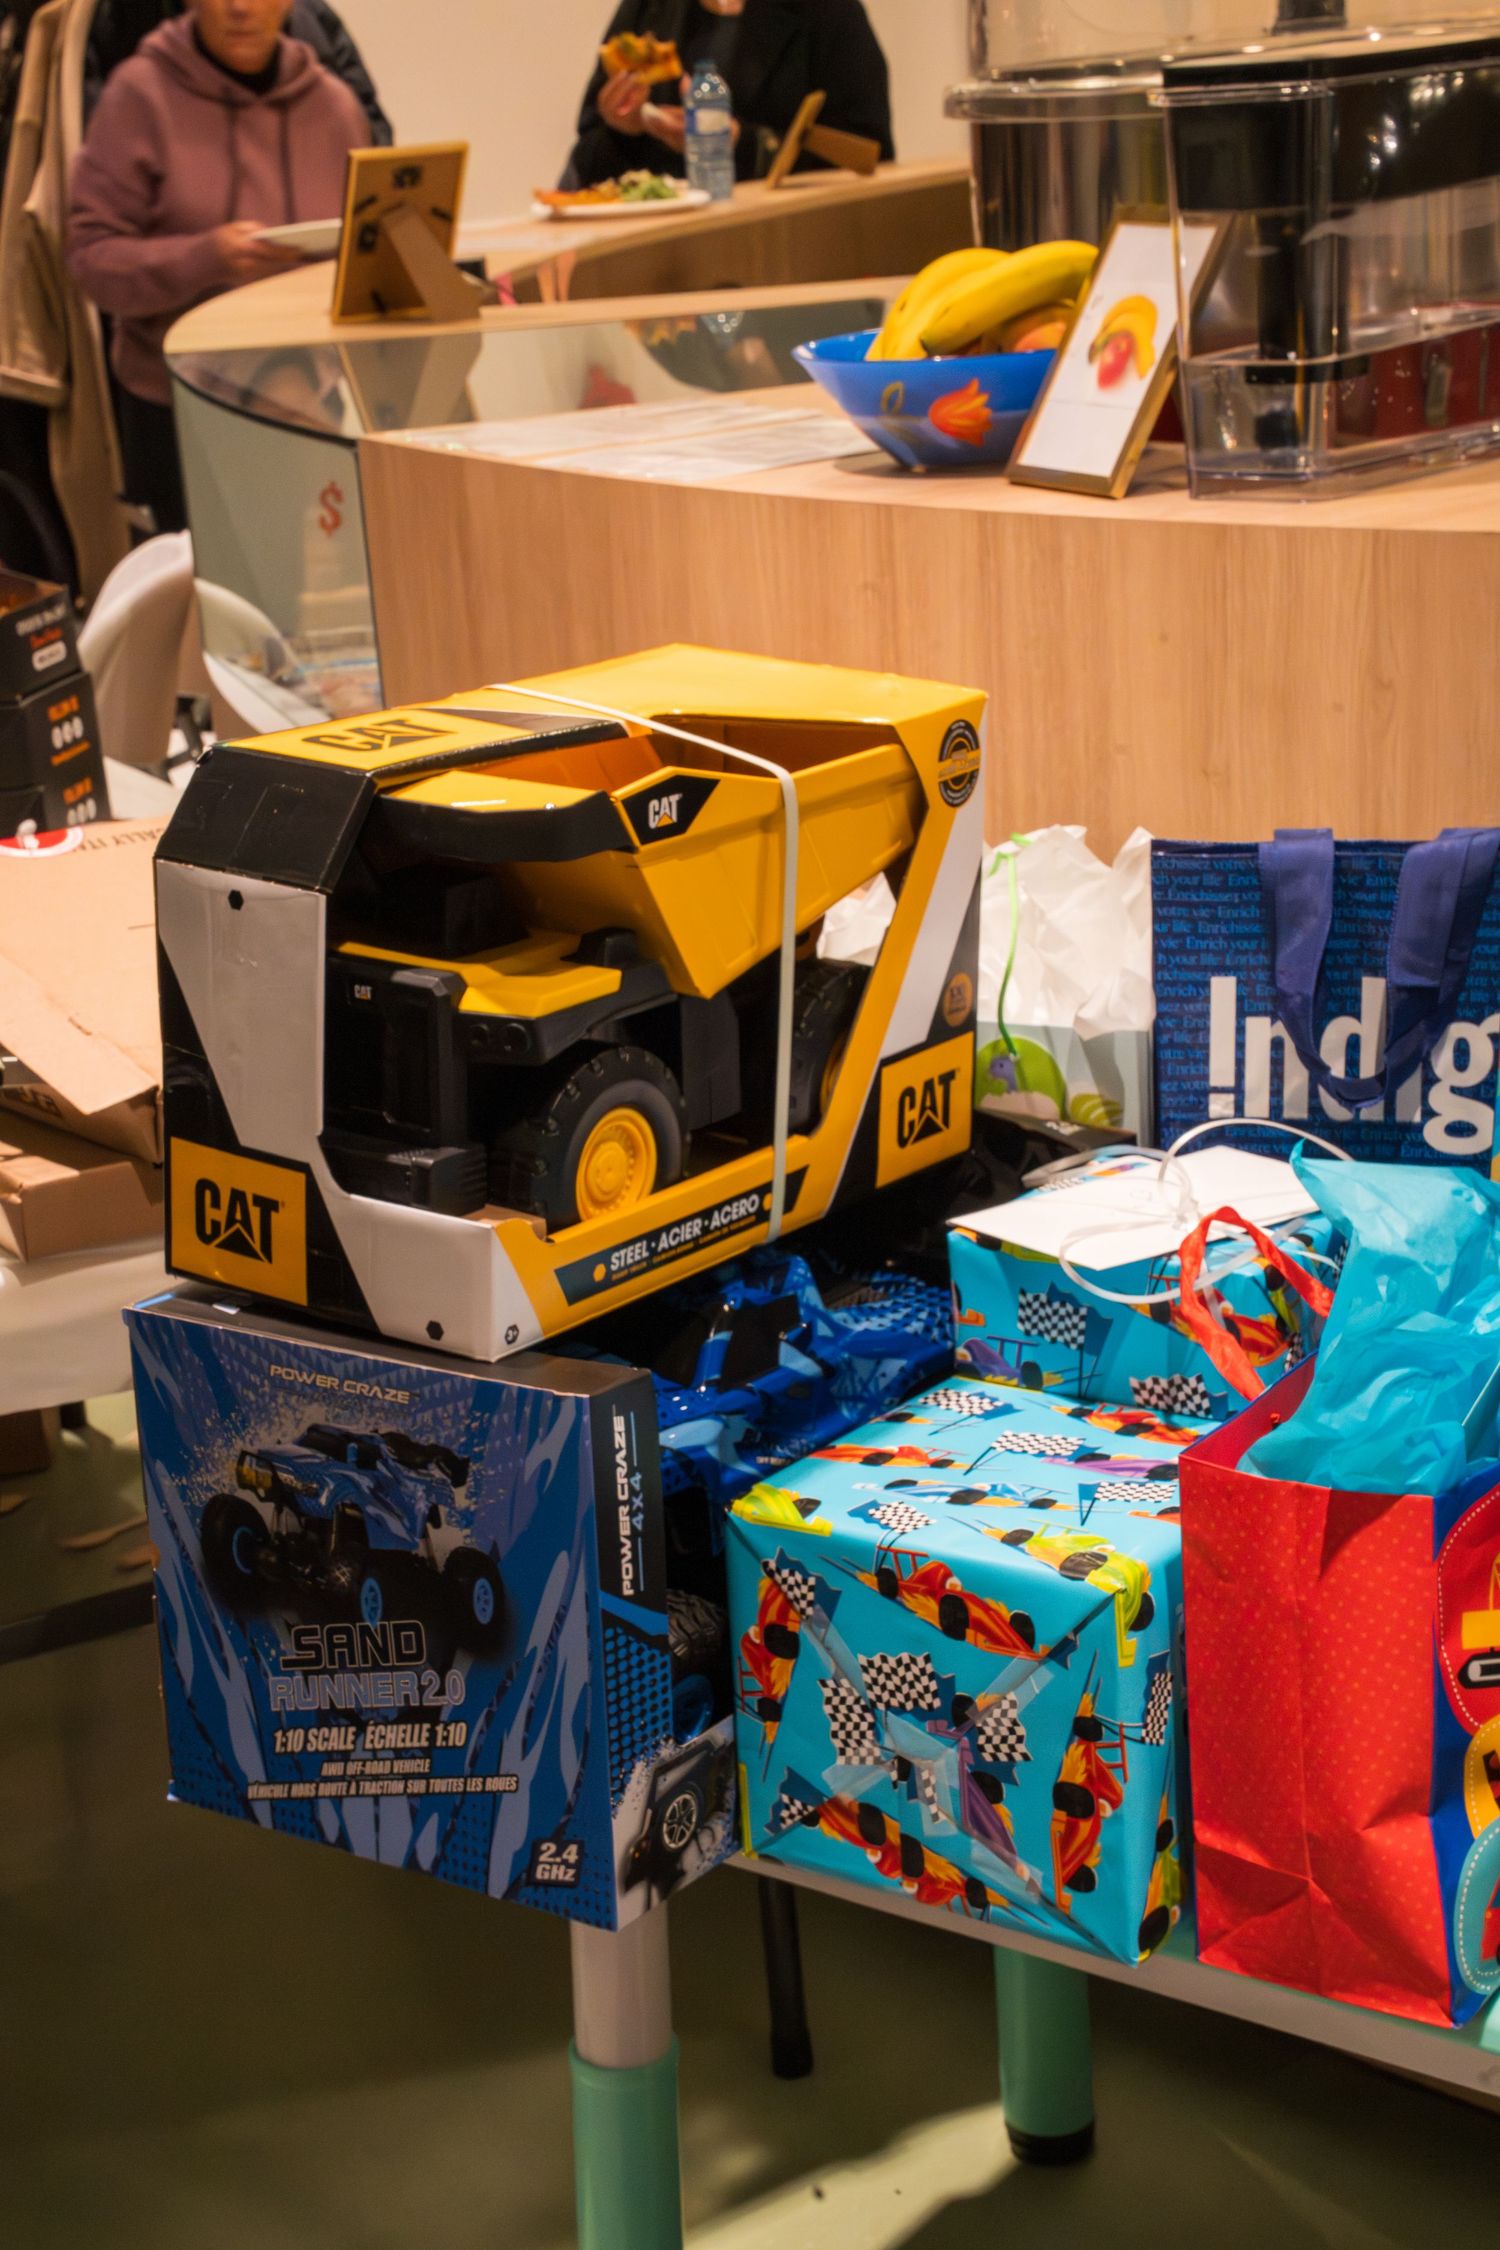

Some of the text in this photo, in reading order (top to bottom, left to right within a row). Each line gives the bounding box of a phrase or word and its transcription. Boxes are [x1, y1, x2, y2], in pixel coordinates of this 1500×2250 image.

[302, 719, 457, 752] CAT
[648, 793, 683, 830] CAT
[354, 984, 372, 1000] CAT
[897, 1068, 956, 1149] CAT
[195, 1177, 280, 1265] CAT
[610, 1240, 650, 1271] STEEL
[657, 1217, 702, 1252] ACIER
[709, 1193, 760, 1231] ACERO
[270, 1364, 410, 1405] POWER CRAZE
[612, 1415, 635, 1597] POWER CRAZE
[280, 1619, 427, 1672] SAND
[269, 1671, 420, 1712] RUNNER
[273, 1720, 468, 1754] 1:10 SCALE ÉCHELLE 1:10
[392, 1758, 431, 1774] VEHICLE
[318, 1781, 348, 1797] ROUTE
[359, 1779, 405, 1795] TRACTION
[406, 1778, 428, 1794] SUR
[428, 1777, 465, 1793] TOUTES
[465, 1776, 484, 1792] LES
[484, 1775, 518, 1792] ROUES
[539, 1842, 579, 1864] 2.4
[535, 1864, 577, 1882] GHz
